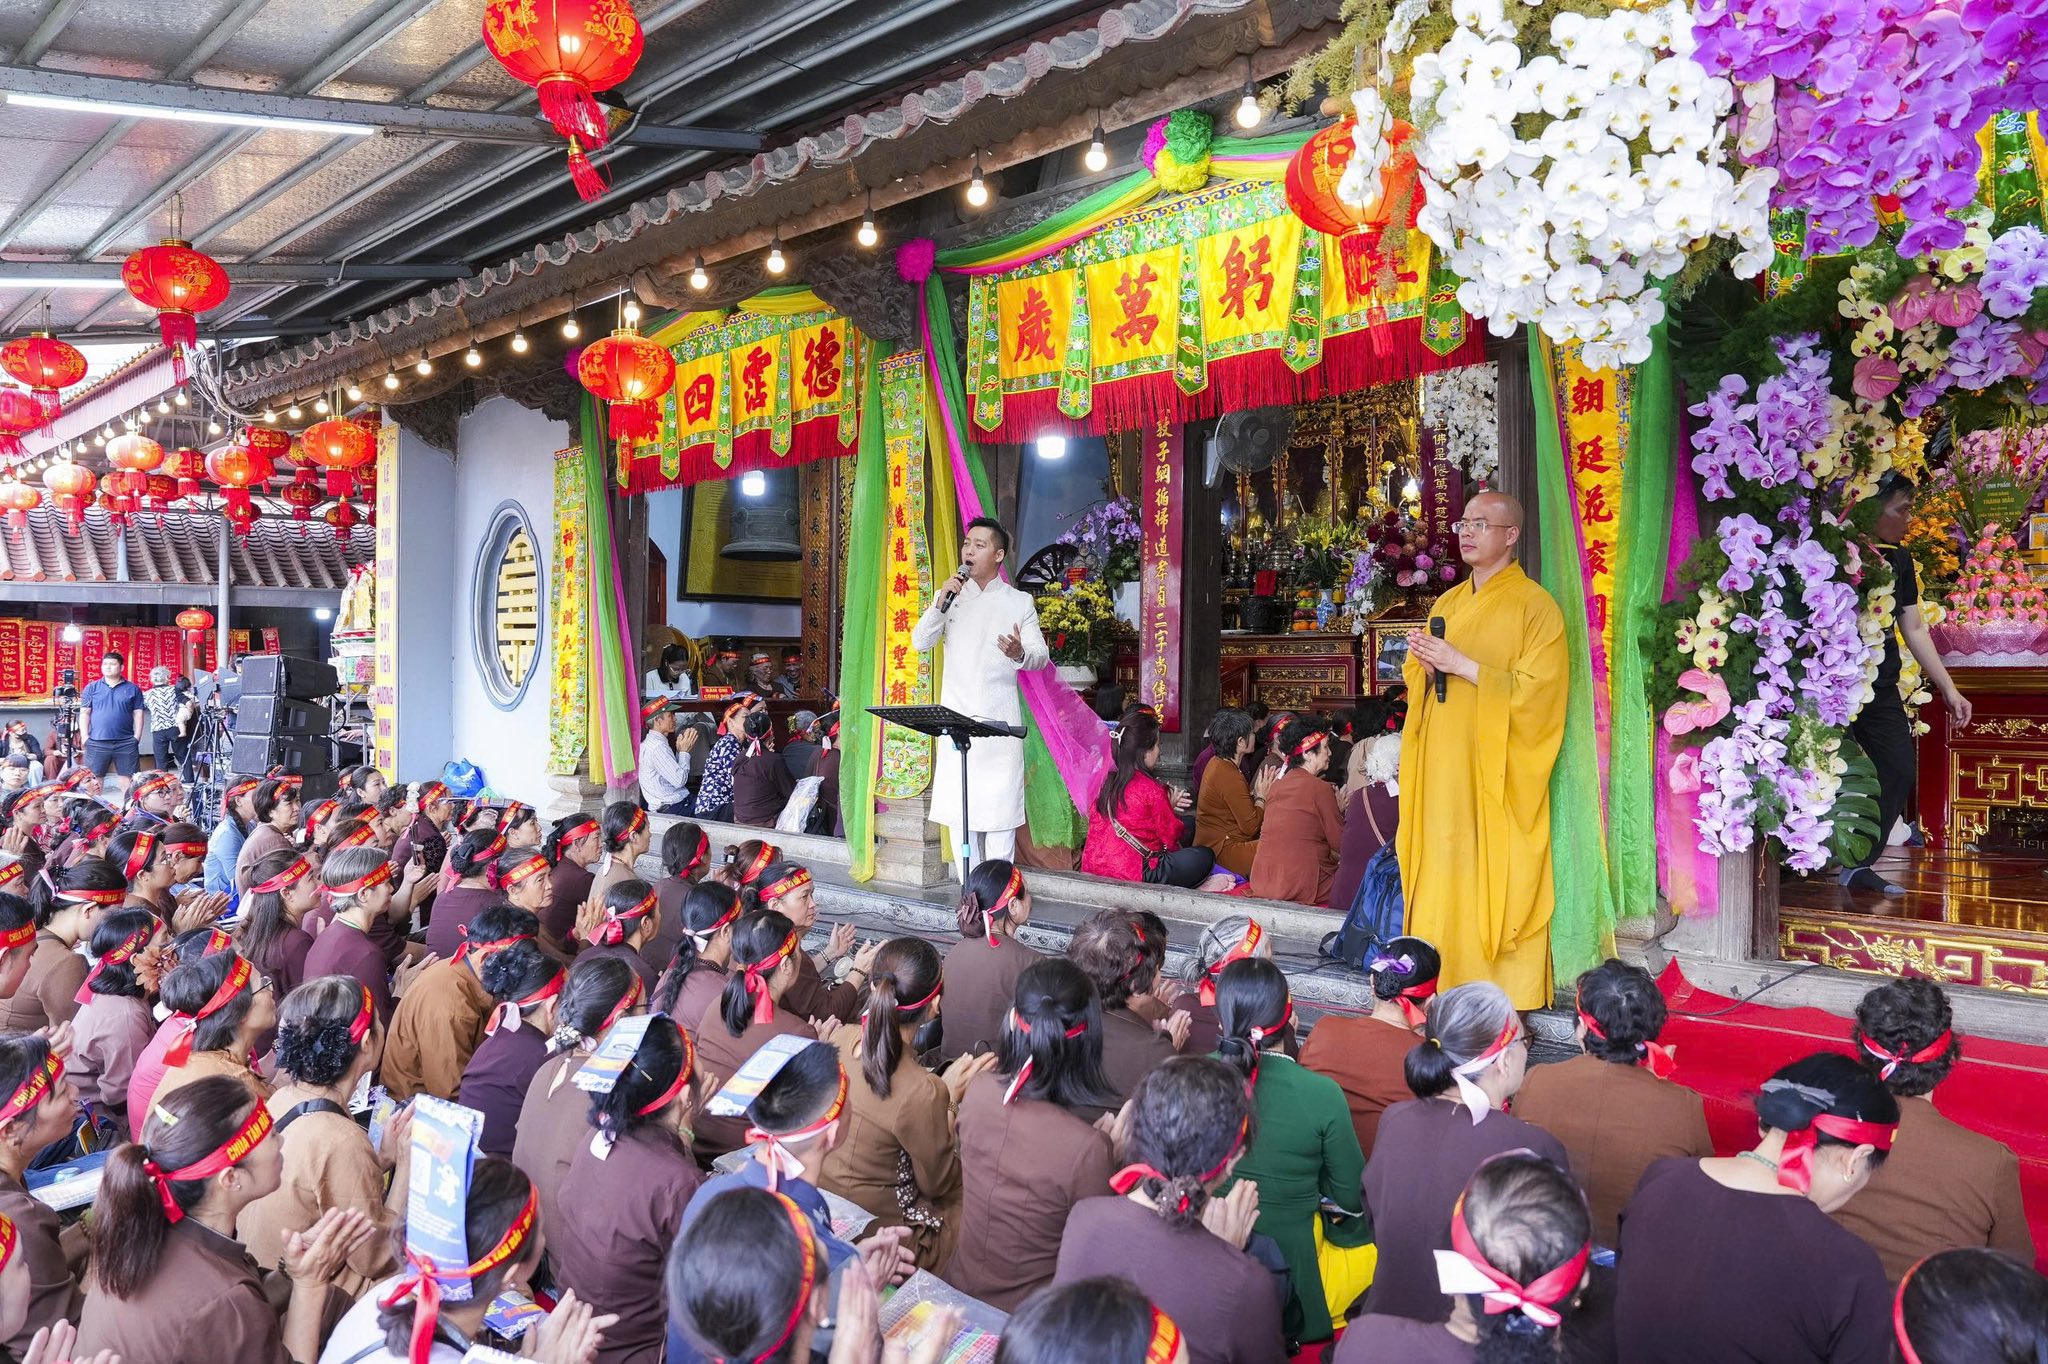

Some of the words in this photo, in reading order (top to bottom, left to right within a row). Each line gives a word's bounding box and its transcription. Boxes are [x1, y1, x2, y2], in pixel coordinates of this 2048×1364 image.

[13, 1085, 39, 1107] CHÙA
[226, 1136, 250, 1161] CHÙA
[245, 1122, 262, 1144] TÂN
